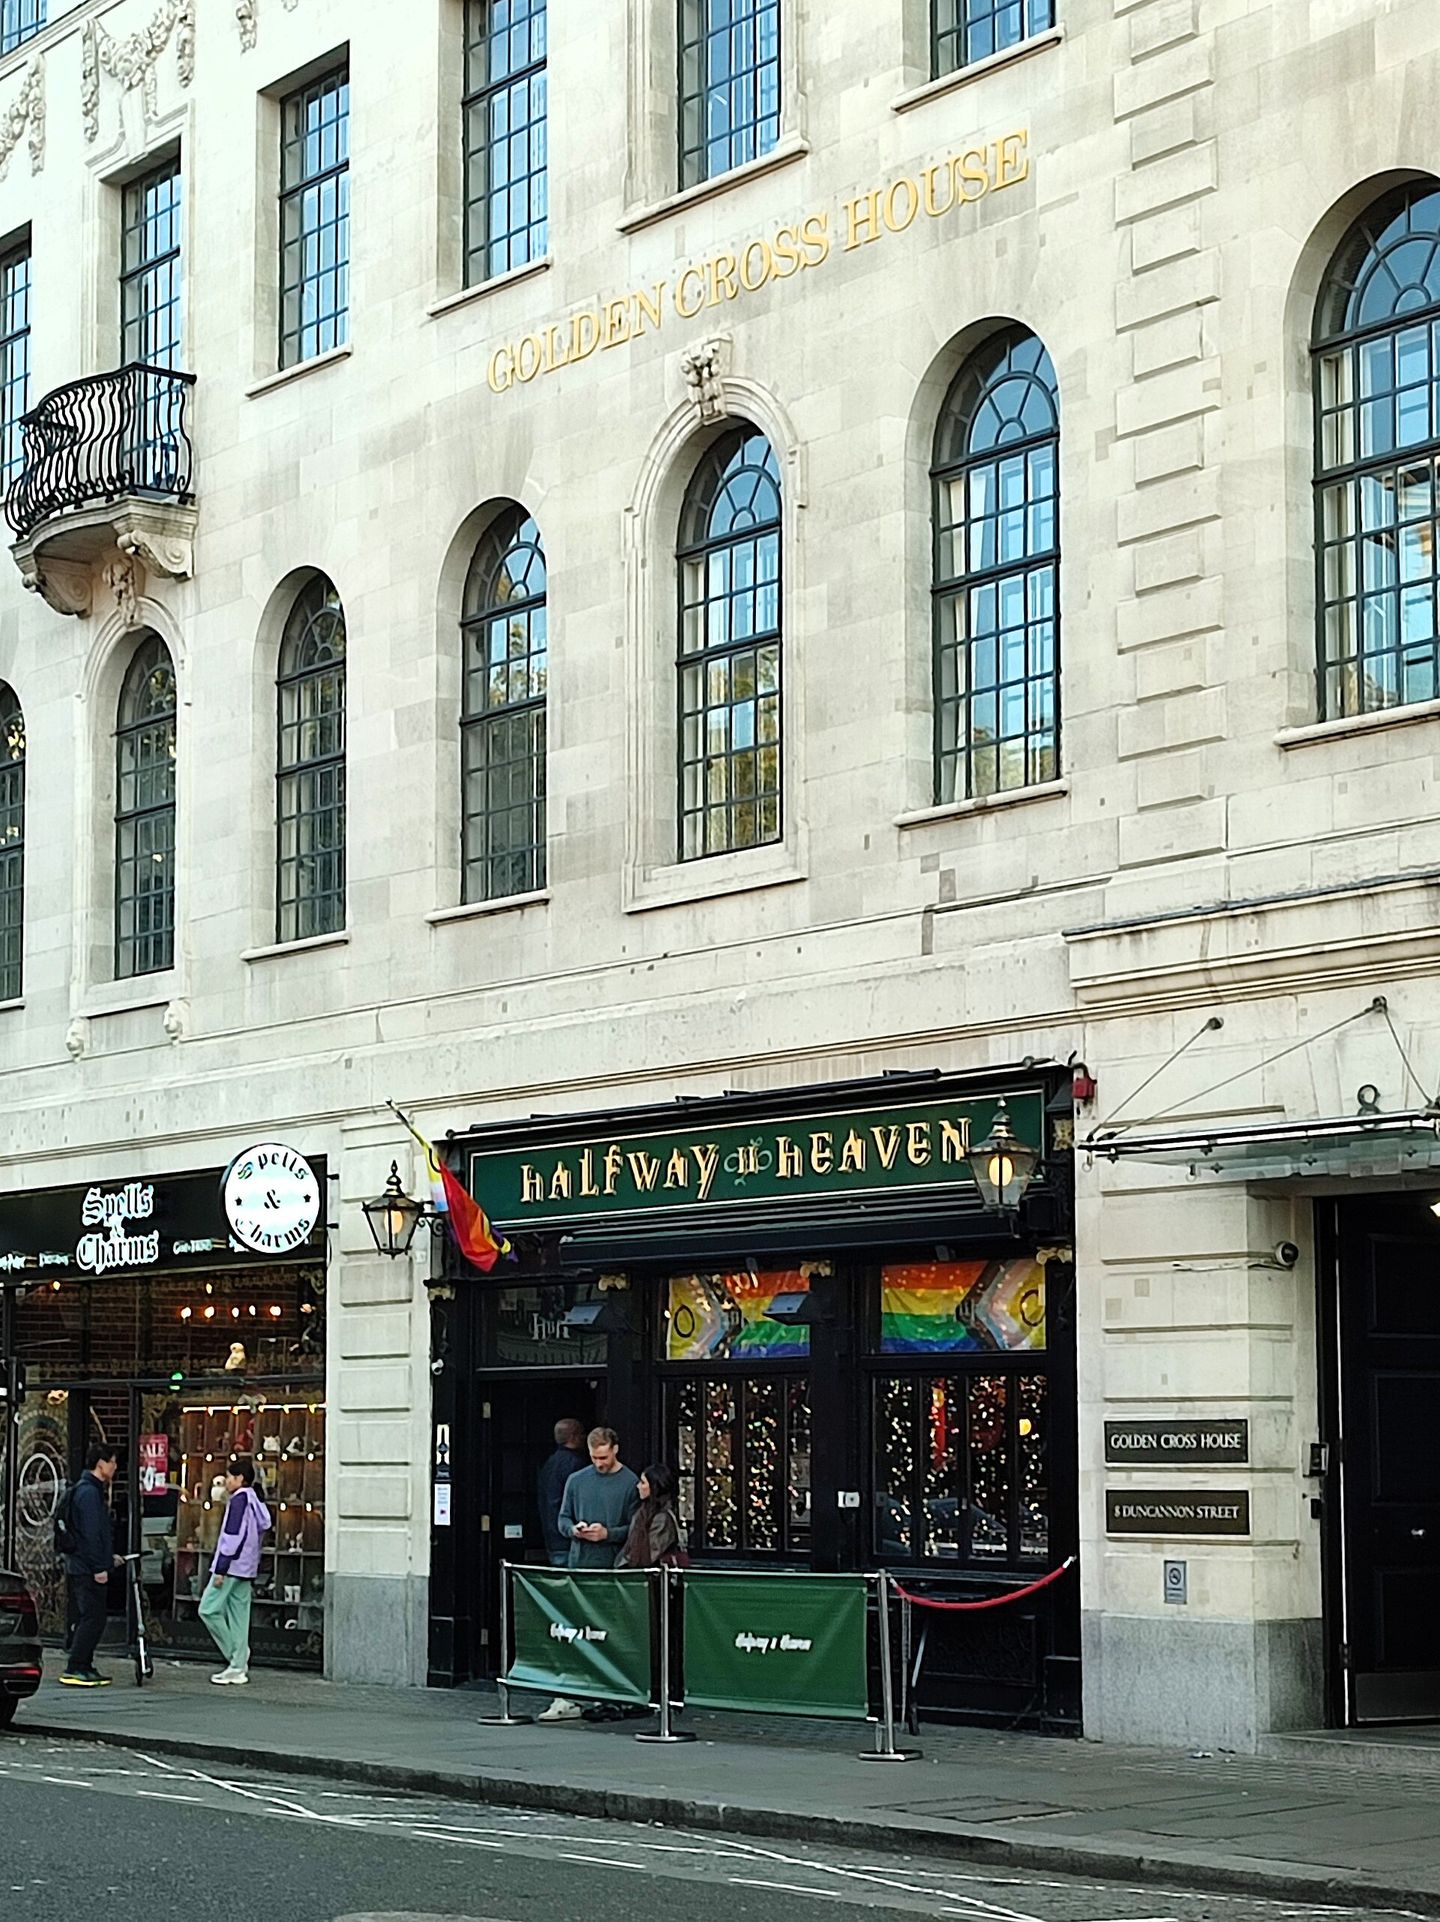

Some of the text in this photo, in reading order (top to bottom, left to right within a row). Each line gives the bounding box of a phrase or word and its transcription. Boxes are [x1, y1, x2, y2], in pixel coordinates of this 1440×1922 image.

[487, 128, 1029, 394] GOLDEN CROSS HOUSE
[237, 1152, 309, 1180] Spells
[520, 1144, 719, 1201] HALFWAY
[775, 1117, 972, 1179] HEAVEN
[82, 1182, 154, 1227] Spells
[263, 1189, 281, 1209] &
[235, 1218, 310, 1248] Charms
[76, 1230, 159, 1275] Charms
[1110, 1432, 1241, 1449] GOLDEN CROSS HOUSE
[1114, 1505, 1239, 1519] 8 DUNCANNON STREET
